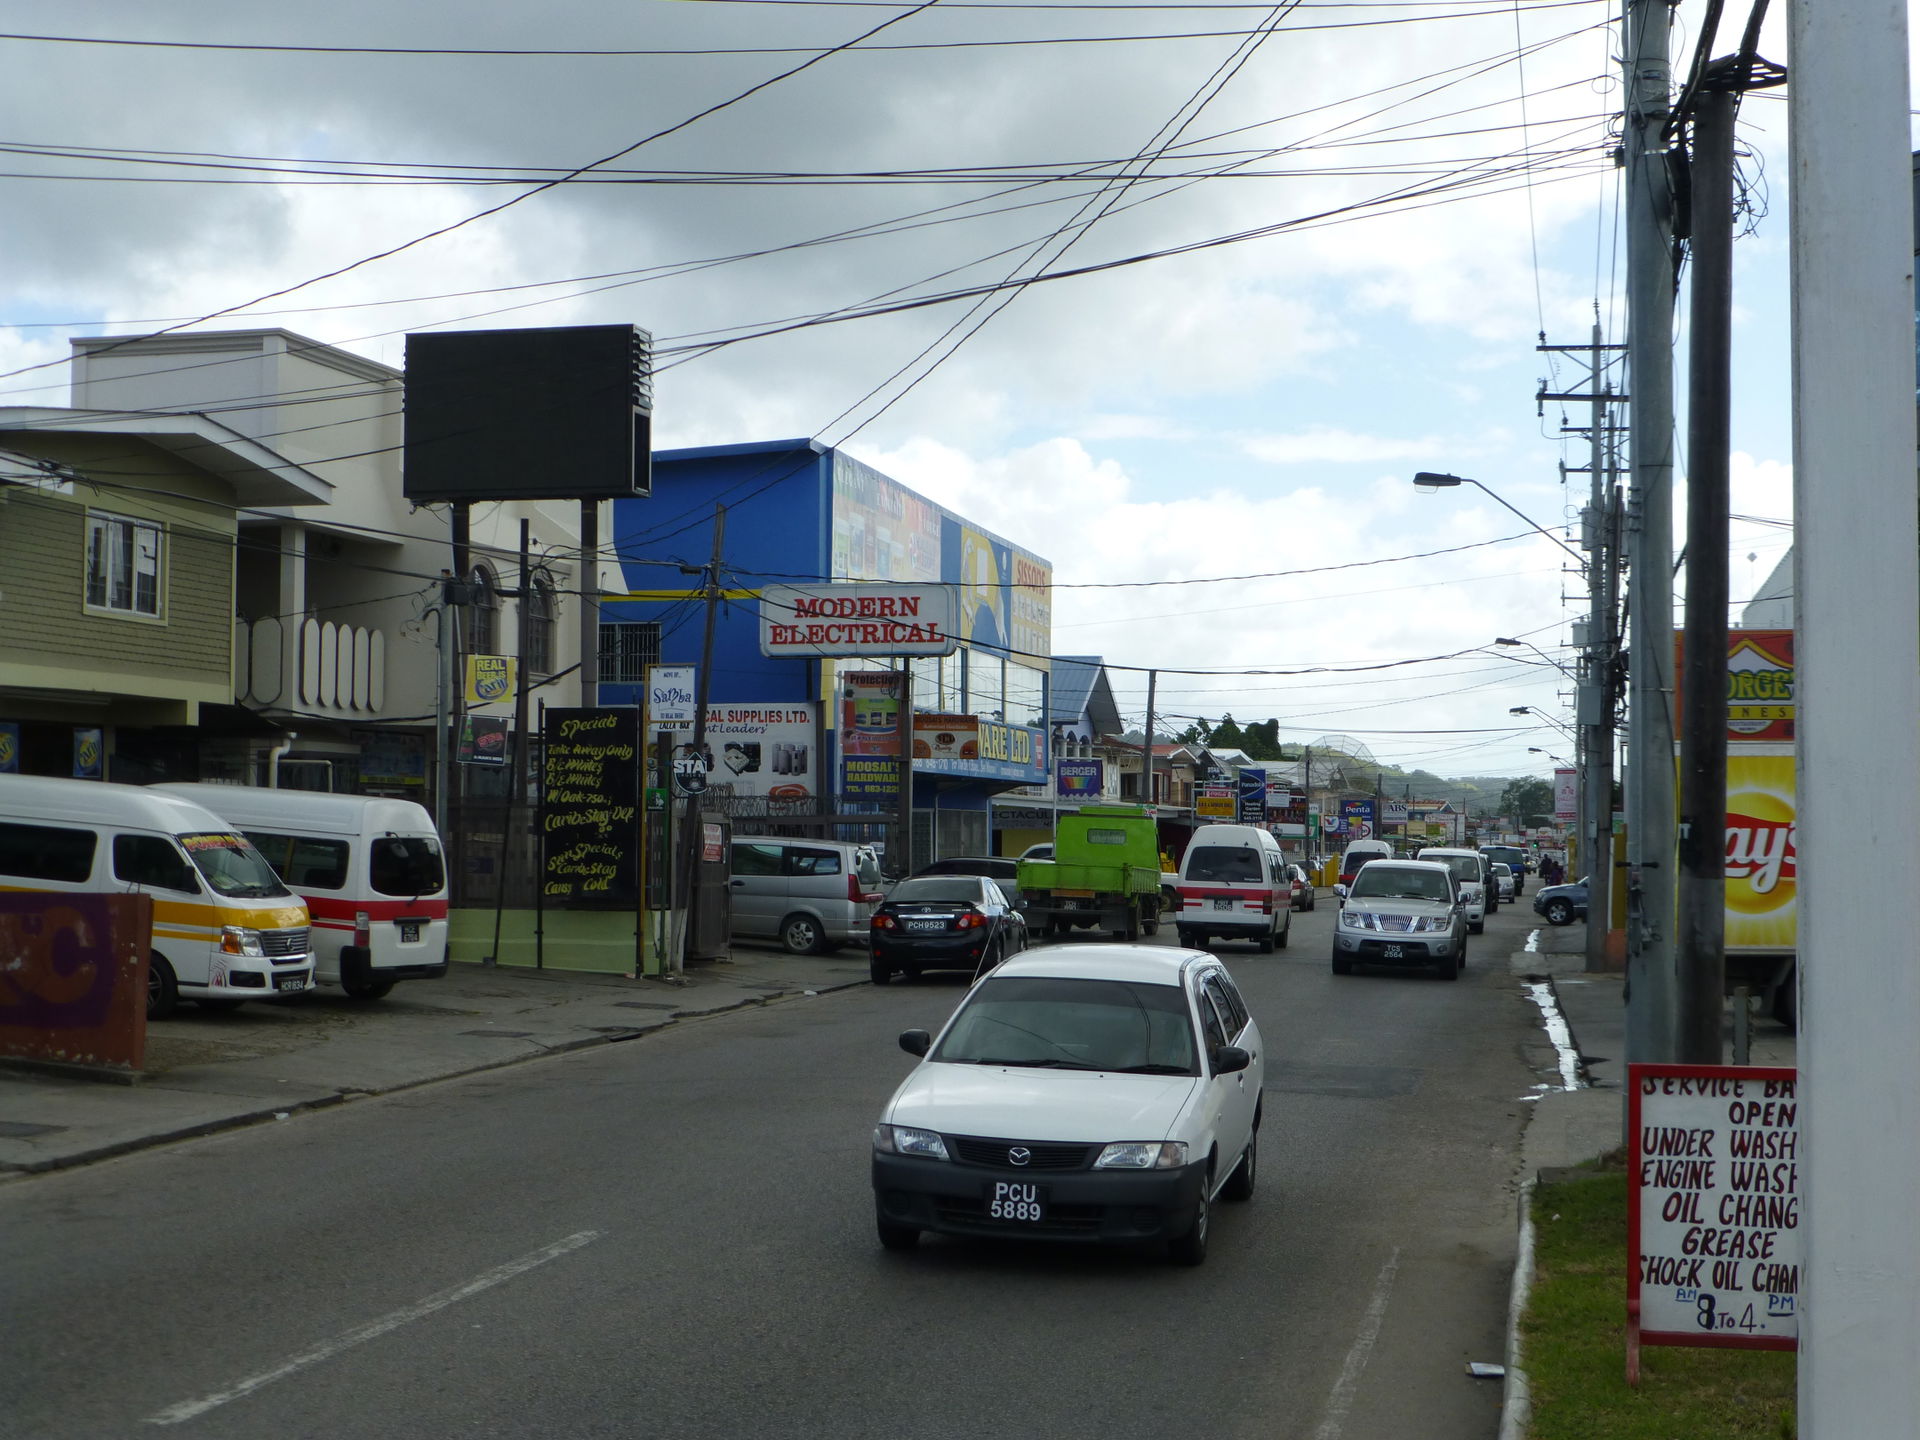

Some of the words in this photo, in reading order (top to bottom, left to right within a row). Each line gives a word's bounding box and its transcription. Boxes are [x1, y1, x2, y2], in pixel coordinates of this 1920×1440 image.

[794, 597, 920, 618] MODERN
[769, 622, 945, 645] ELECTRICAL
[476, 659, 505, 671] REAL
[727, 710, 783, 723] SUPPLIES
[786, 711, 810, 723] LTD.
[720, 723, 768, 735] Leaders'
[1010, 728, 1031, 765] LTD.
[673, 759, 708, 774] STA
[1060, 766, 1097, 776] BERGER
[1345, 806, 1371, 814] Penta
[1389, 804, 1407, 812] ABS
[1386, 944, 1401, 952] TCS
[1642, 1077, 1744, 1098] SERVICE
[1763, 1078, 1796, 1098] BA
[1728, 1101, 1796, 1127] OPEN
[1642, 1127, 1715, 1157] UNDER
[1730, 1130, 1796, 1160] WASH
[1640, 1159, 1716, 1189] ENGINE
[995, 1182, 1037, 1203] PCU
[990, 1200, 1042, 1222] 5889
[1662, 1192, 1704, 1224] OIL
[1681, 1226, 1777, 1259] GREASE
[1712, 1260, 1743, 1291] OIL
[1676, 1288, 1697, 1300] AM
[1768, 1294, 1794, 1311] PM
